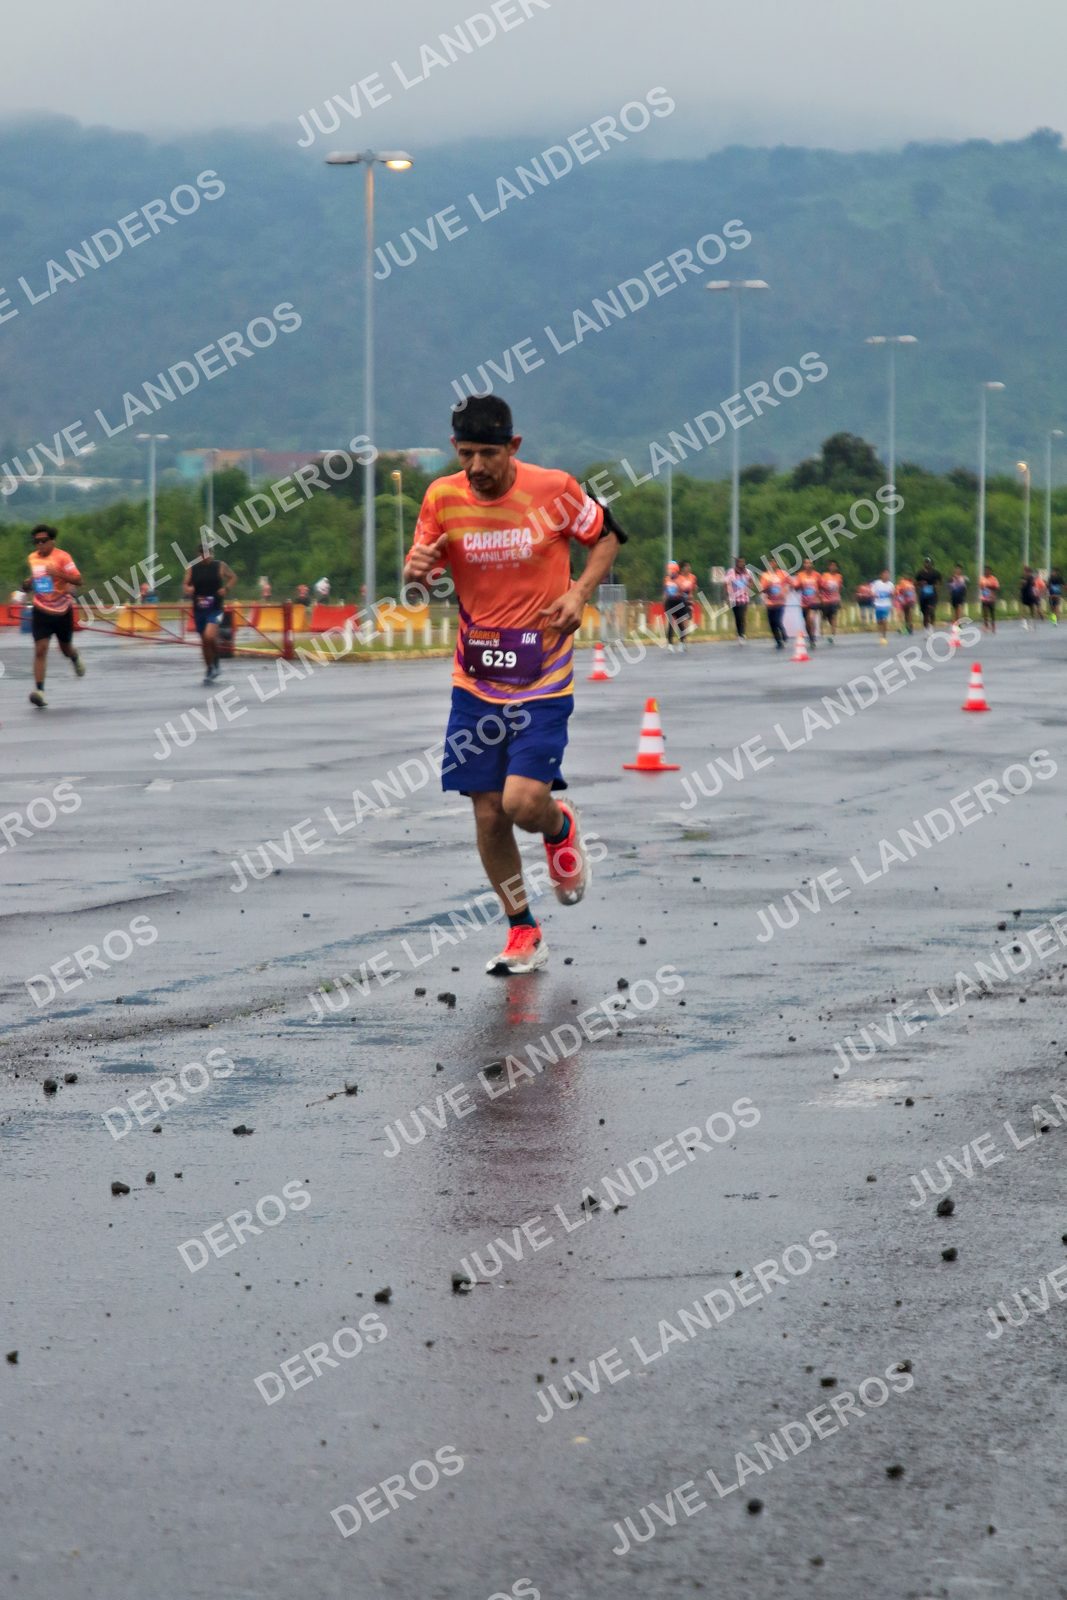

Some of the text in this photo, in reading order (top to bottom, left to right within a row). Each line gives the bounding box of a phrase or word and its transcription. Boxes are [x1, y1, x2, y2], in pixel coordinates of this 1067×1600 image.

[463, 528, 531, 550] CARRERA
[466, 549, 517, 562] OMNILIFE
[482, 650, 517, 668] 629
